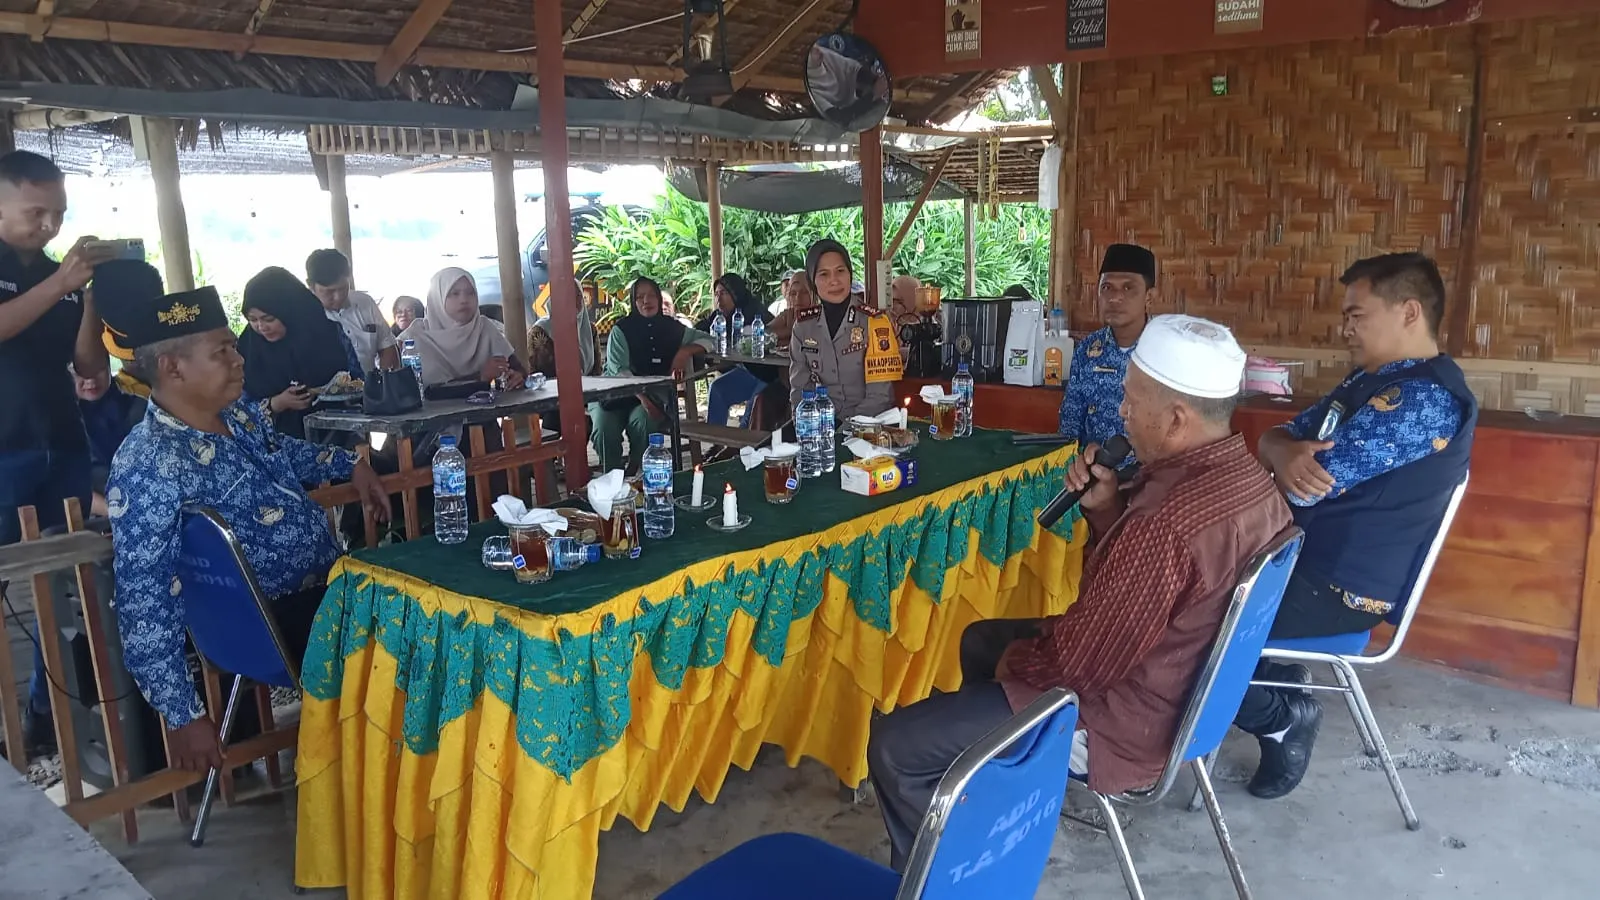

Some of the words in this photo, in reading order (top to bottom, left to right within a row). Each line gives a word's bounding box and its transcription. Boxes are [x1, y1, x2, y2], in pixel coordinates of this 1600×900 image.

[1217, 0, 1260, 12] SUDAHI
[1217, 11, 1259, 22] sedihmu
[946, 32, 964, 42] NYARI
[965, 31, 978, 40] DUIT
[945, 43, 963, 53] CUMA
[963, 41, 978, 51] HOBI
[649, 472, 668, 481] AQUA
[986, 788, 1041, 840] ADD
[1000, 796, 1058, 857] 2016
